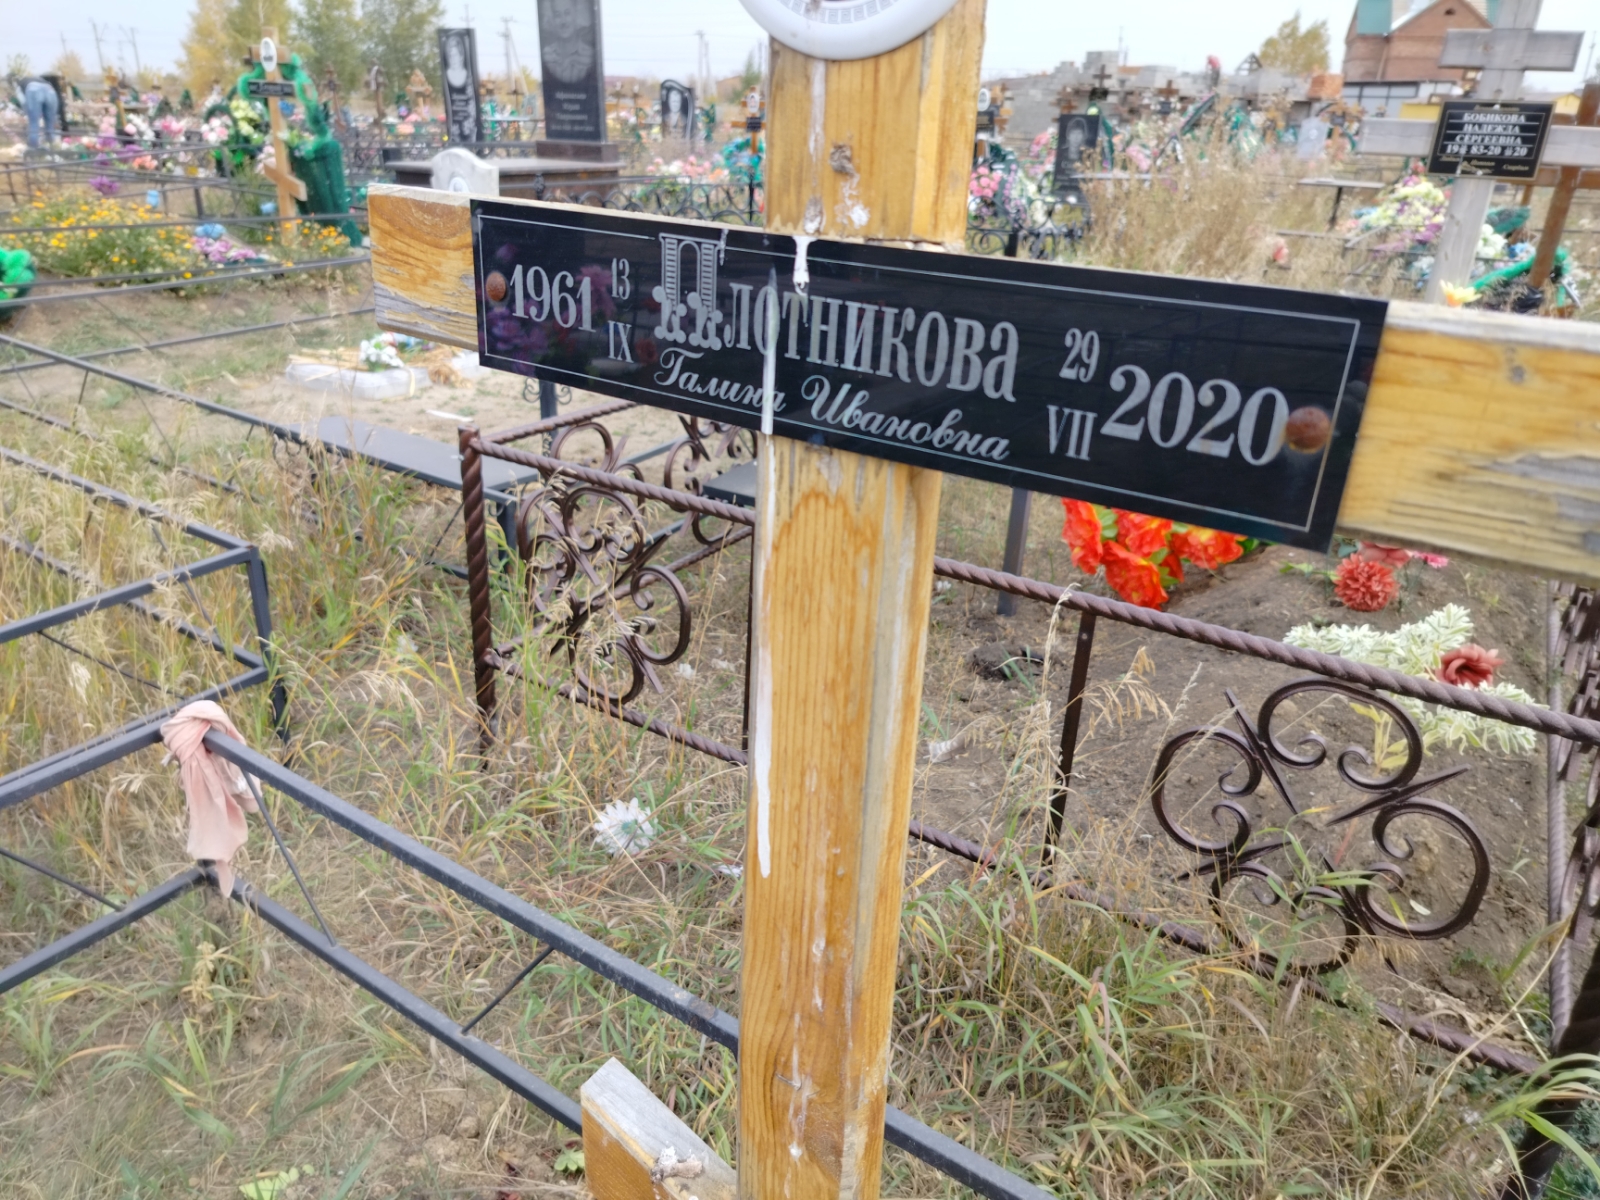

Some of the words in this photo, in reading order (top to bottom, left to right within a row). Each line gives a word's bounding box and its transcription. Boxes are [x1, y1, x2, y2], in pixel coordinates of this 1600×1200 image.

[1455, 133, 1522, 145] СЕРГЕЕВНА
[1462, 123, 1520, 134] НАДЕЖДА
[510, 264, 597, 333] 1961
[611, 258, 631, 300] 13
[607, 320, 634, 364] IX
[1059, 328, 1100, 383] 29
[801, 375, 1010, 461] Ивановна
[1047, 404, 1098, 461] VII
[1100, 364, 1290, 466] 2020
